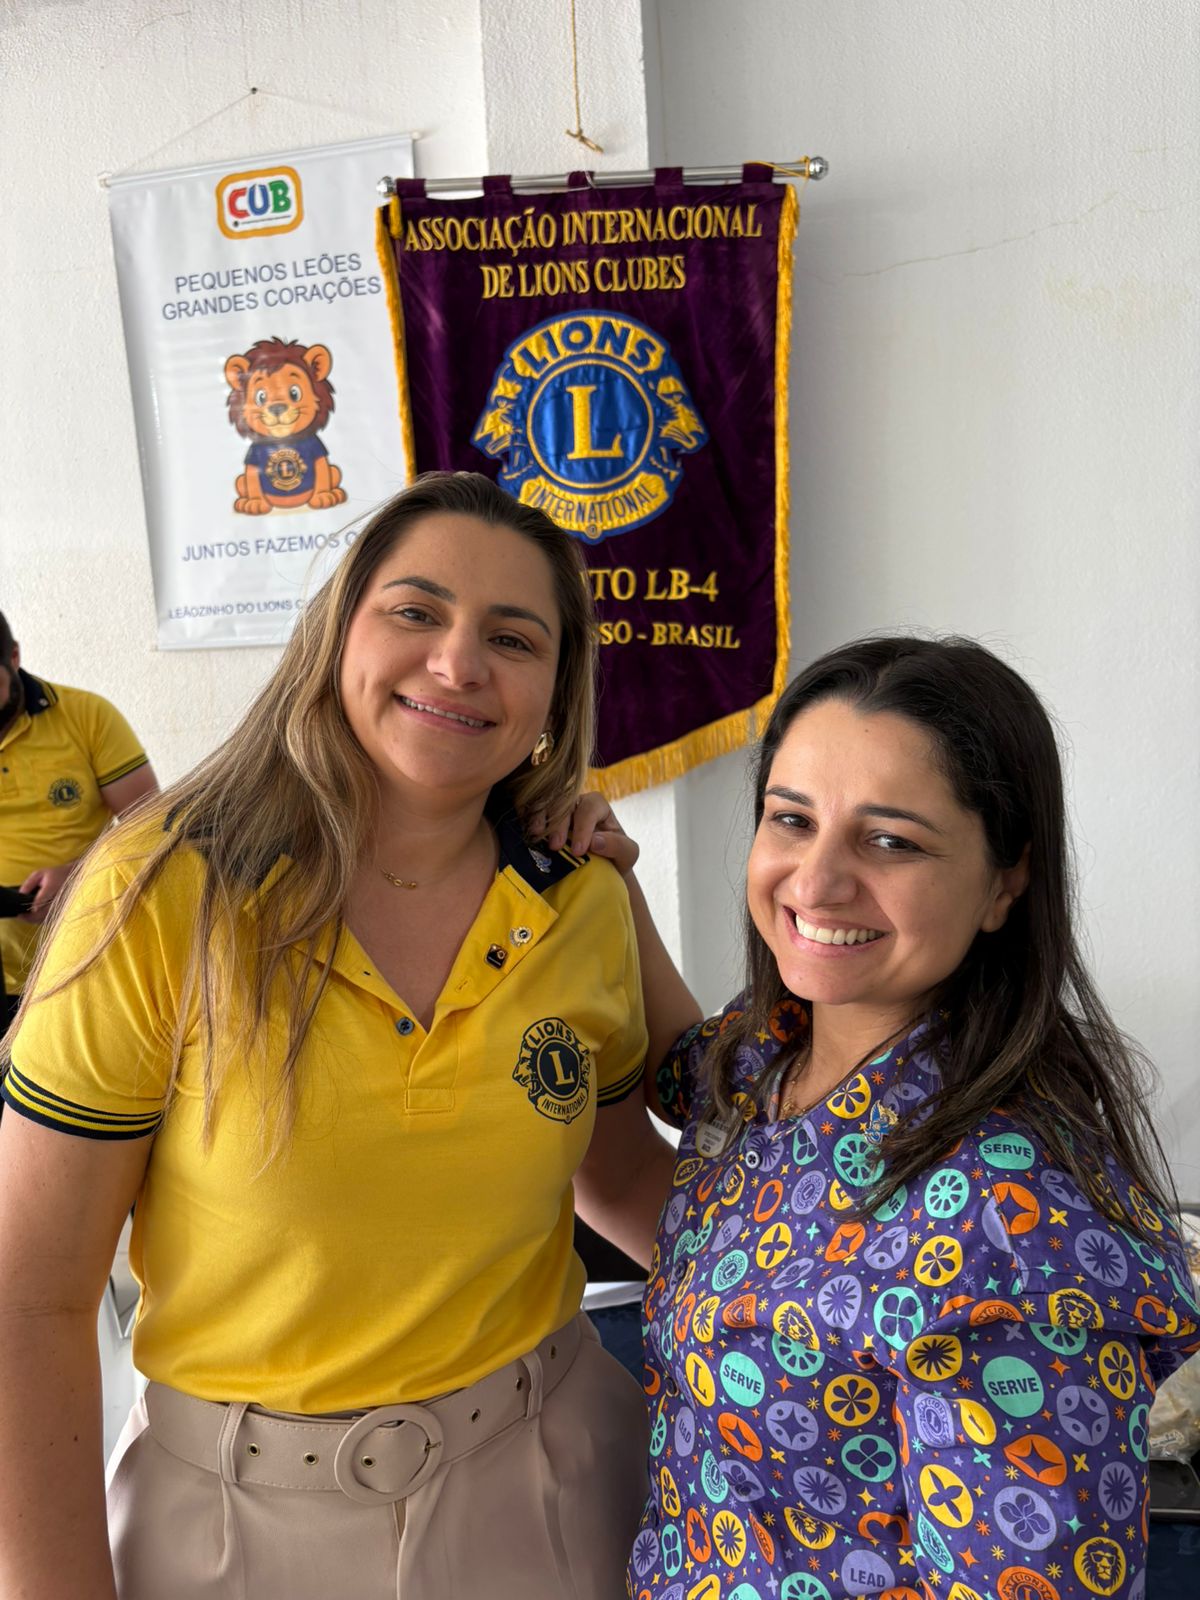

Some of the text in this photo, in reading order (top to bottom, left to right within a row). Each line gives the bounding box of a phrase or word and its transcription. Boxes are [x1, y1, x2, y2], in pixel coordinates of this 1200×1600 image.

[228, 180, 291, 219] CUB
[561, 204, 764, 246] INTERNACIONAL
[175, 253, 362, 294] PEQUENOS LEÕES
[480, 255, 687, 299] DE LIONS CLUBES
[162, 276, 382, 320] GRANDES CORAÇÕES
[518, 320, 658, 375] LIONS
[565, 384, 624, 461] L
[527, 484, 658, 523] INTERNATIONAL
[182, 541, 251, 562] JUNTOS
[255, 533, 340, 555] FAZEMOS
[584, 567, 719, 602] TO LB-4
[236, 602, 255, 614] DO
[257, 600, 293, 613] LIONS
[596, 620, 633, 646] SO
[651, 622, 741, 649] BRASIL
[528, 1021, 573, 1044] LIONS
[548, 1050, 576, 1086] L
[541, 1093, 584, 1115] INTERNATIONAL
[983, 1143, 1031, 1159] SERVE
[722, 1364, 762, 1395] SERVE
[987, 1377, 1040, 1396] SERVE
[850, 1567, 886, 1588] LEAD
